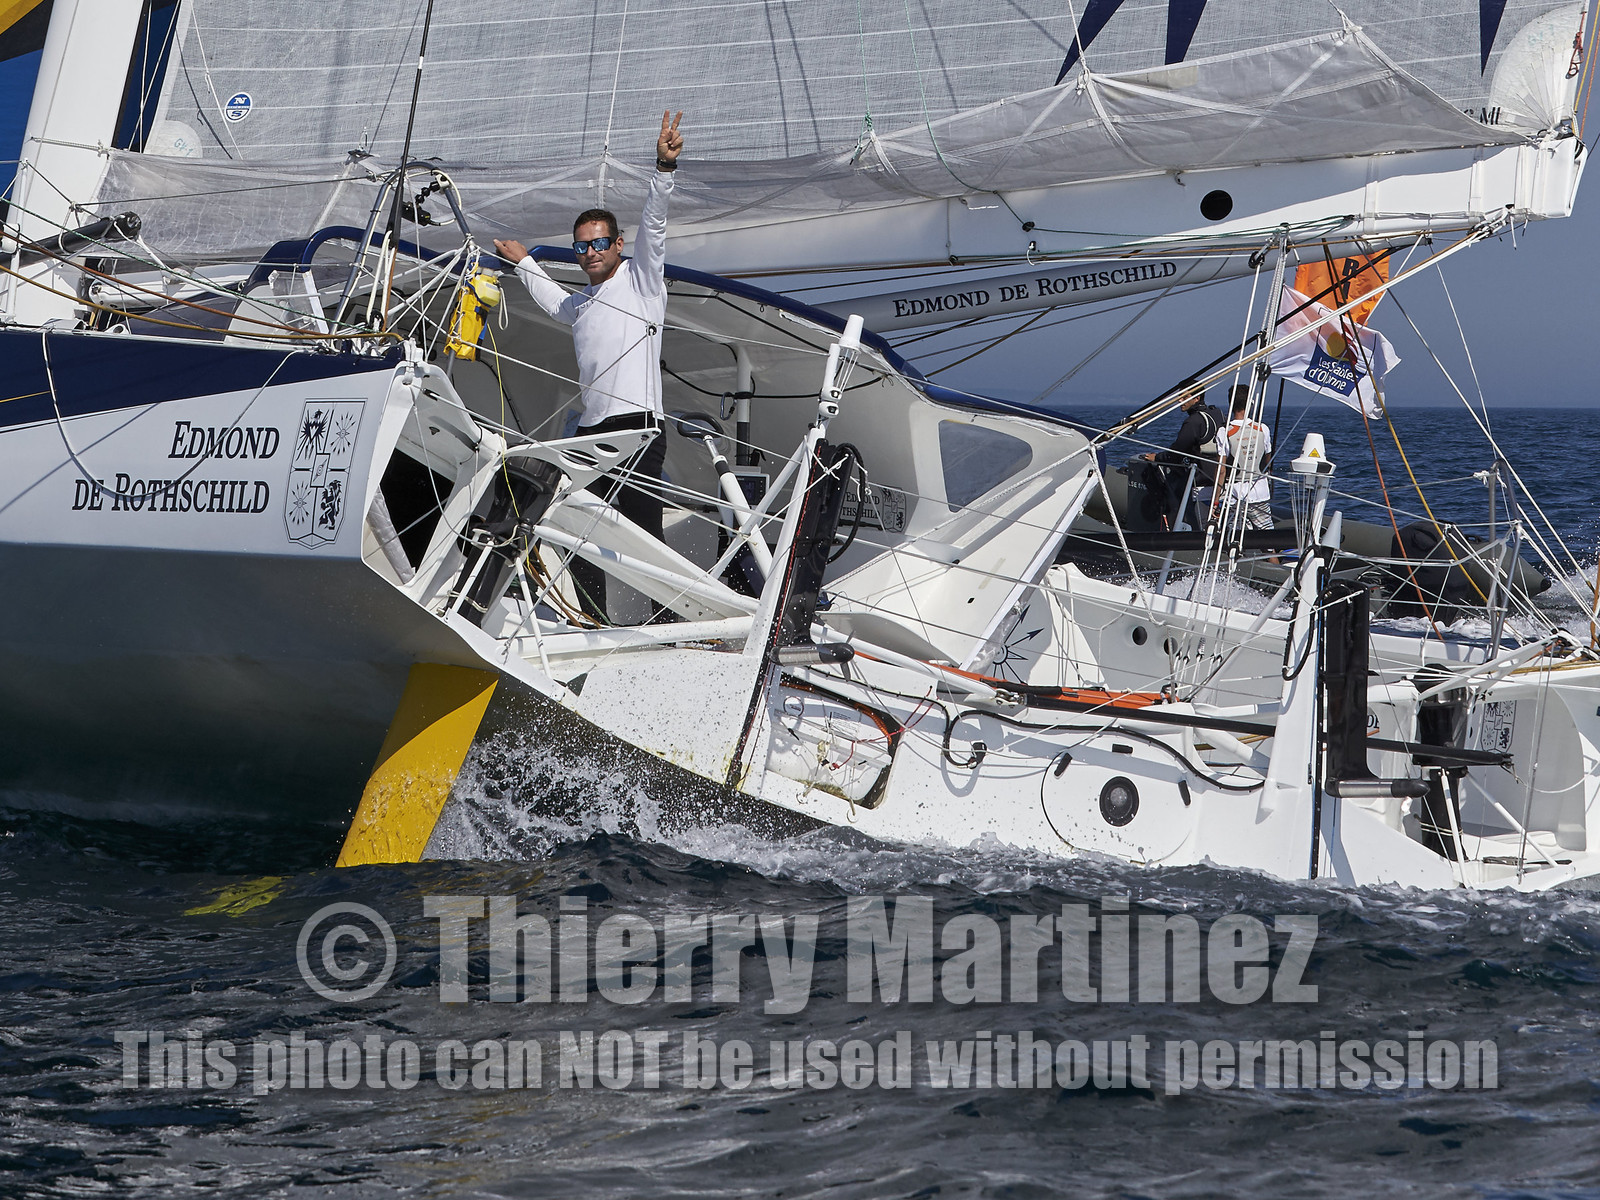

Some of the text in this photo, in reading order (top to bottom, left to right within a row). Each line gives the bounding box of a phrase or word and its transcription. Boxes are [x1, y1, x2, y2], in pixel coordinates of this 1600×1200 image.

[892, 261, 1178, 318] EDMOND DE ROTHSCHILD
[1318, 357, 1331, 370] Les
[168, 421, 280, 459] EDMOND
[72, 473, 270, 513] DE ROTHSCHILD
[846, 492, 880, 505] EDOND
